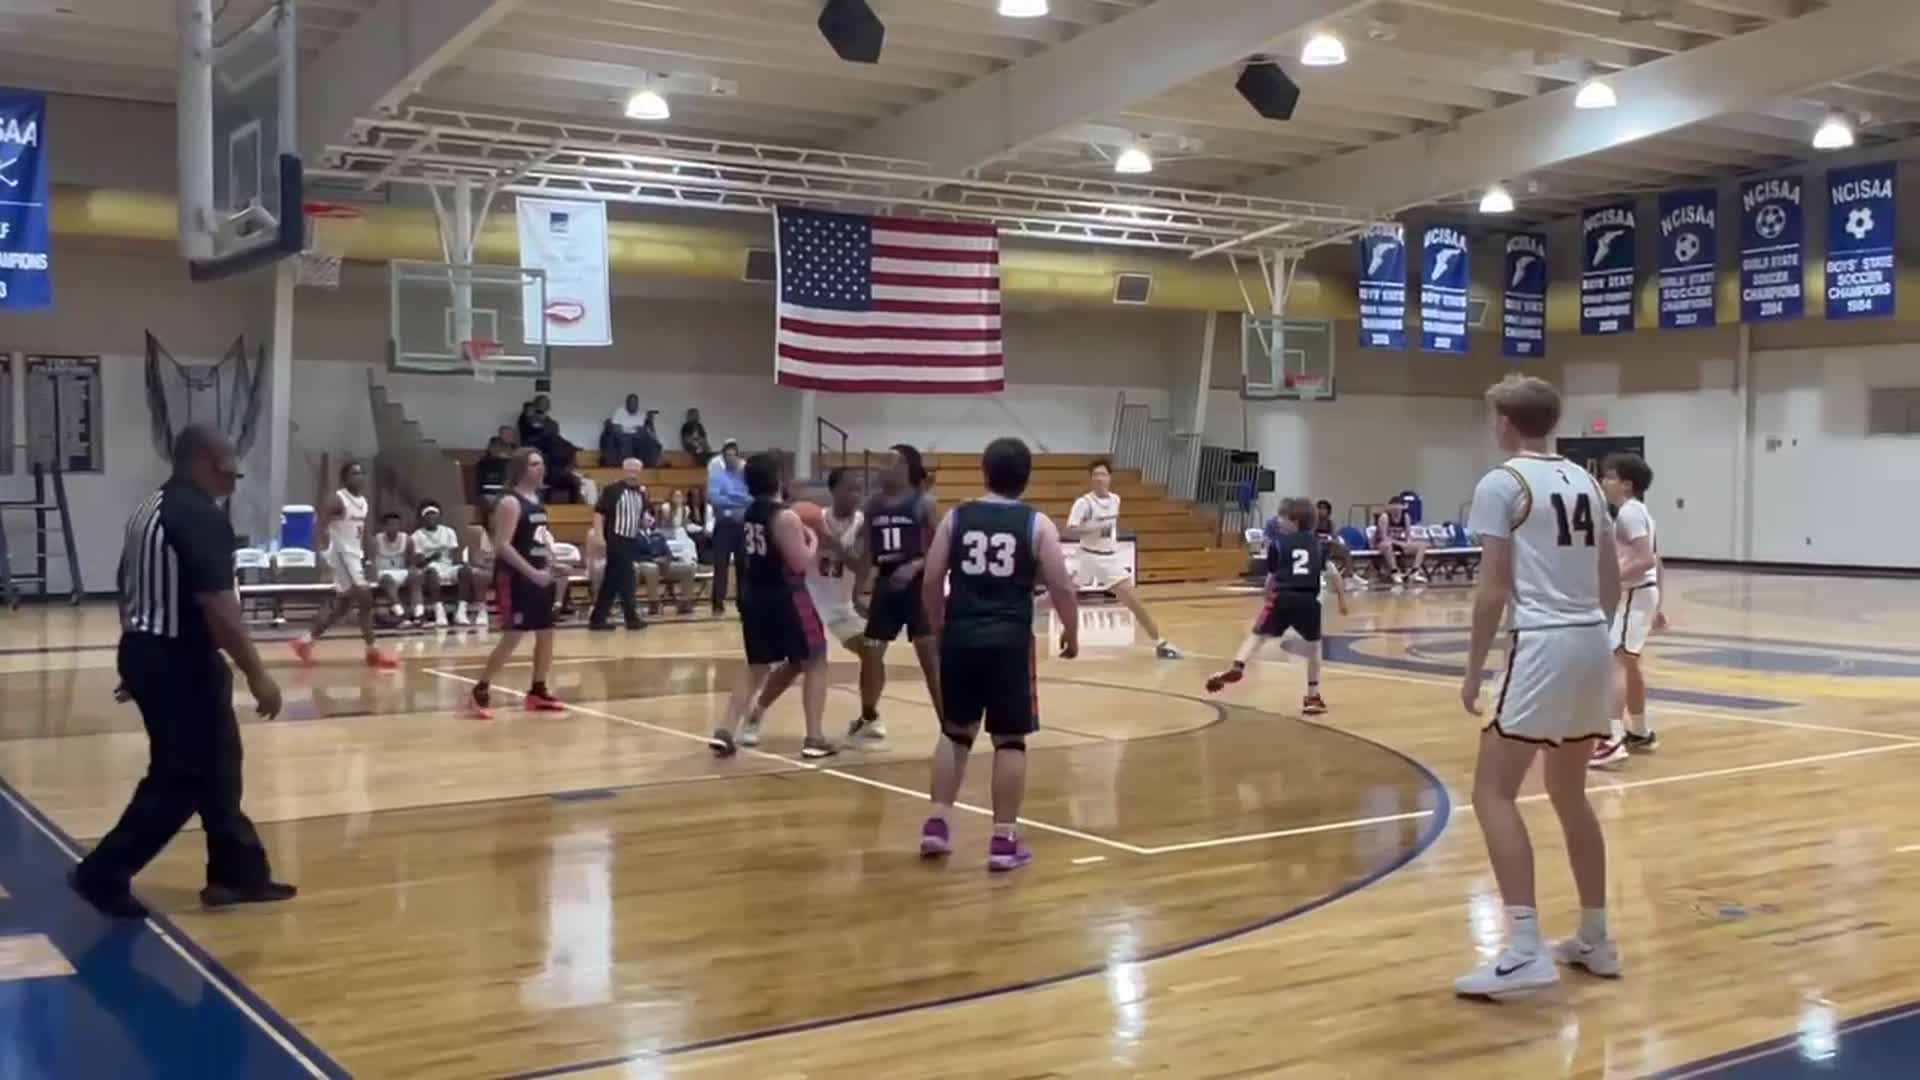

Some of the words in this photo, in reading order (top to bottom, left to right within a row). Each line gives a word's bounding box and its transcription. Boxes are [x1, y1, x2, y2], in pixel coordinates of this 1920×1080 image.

[1742, 179, 1800, 211] NCISAA
[1831, 179, 1893, 205] NCISAA
[1583, 209, 1635, 234] NCISAA
[1660, 205, 1715, 236] NCISAA
[1828, 282, 1891, 300] CHAMPIONS
[1837, 270, 1883, 286] SOCCER
[1743, 283, 1800, 301] CHAMPIONS
[1550, 493, 1595, 546] 14
[743, 521, 767, 556] 35
[881, 527, 901, 551] 11
[961, 530, 1016, 577] 33
[1291, 548, 1310, 575] 2
